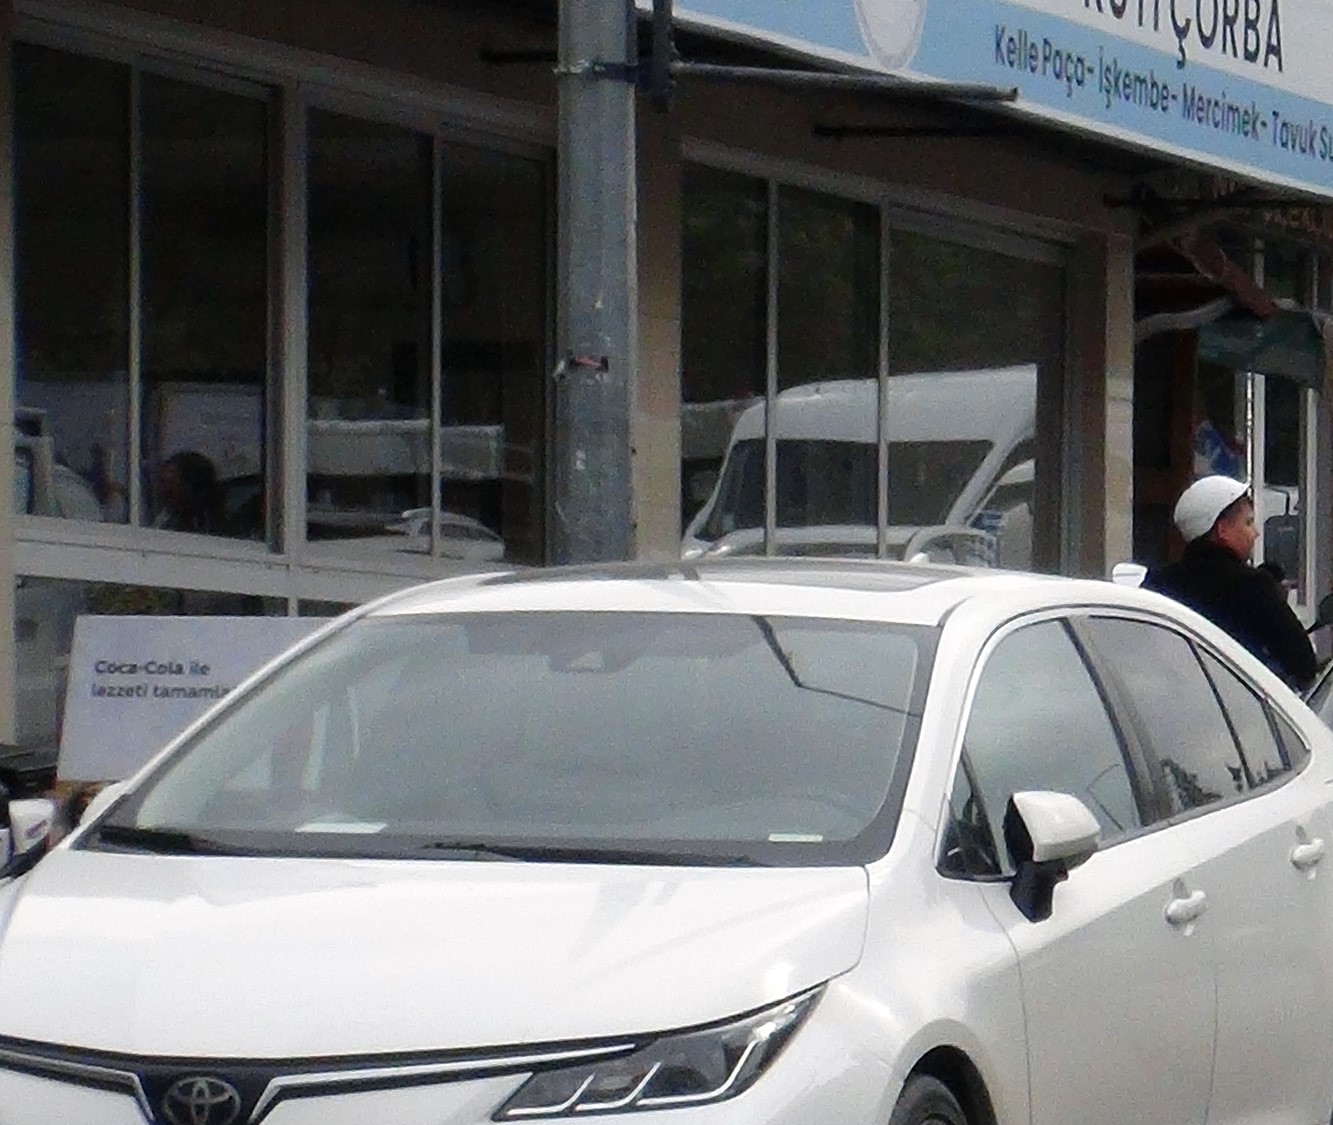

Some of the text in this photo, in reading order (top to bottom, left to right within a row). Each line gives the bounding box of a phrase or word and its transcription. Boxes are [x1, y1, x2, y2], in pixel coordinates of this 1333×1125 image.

[994, 24, 1039, 74] Kelle
[1271, 109, 1317, 158] Tavuk
[95, 660, 185, 675] Coca-Cola
[91, 683, 147, 698] lezzeti
